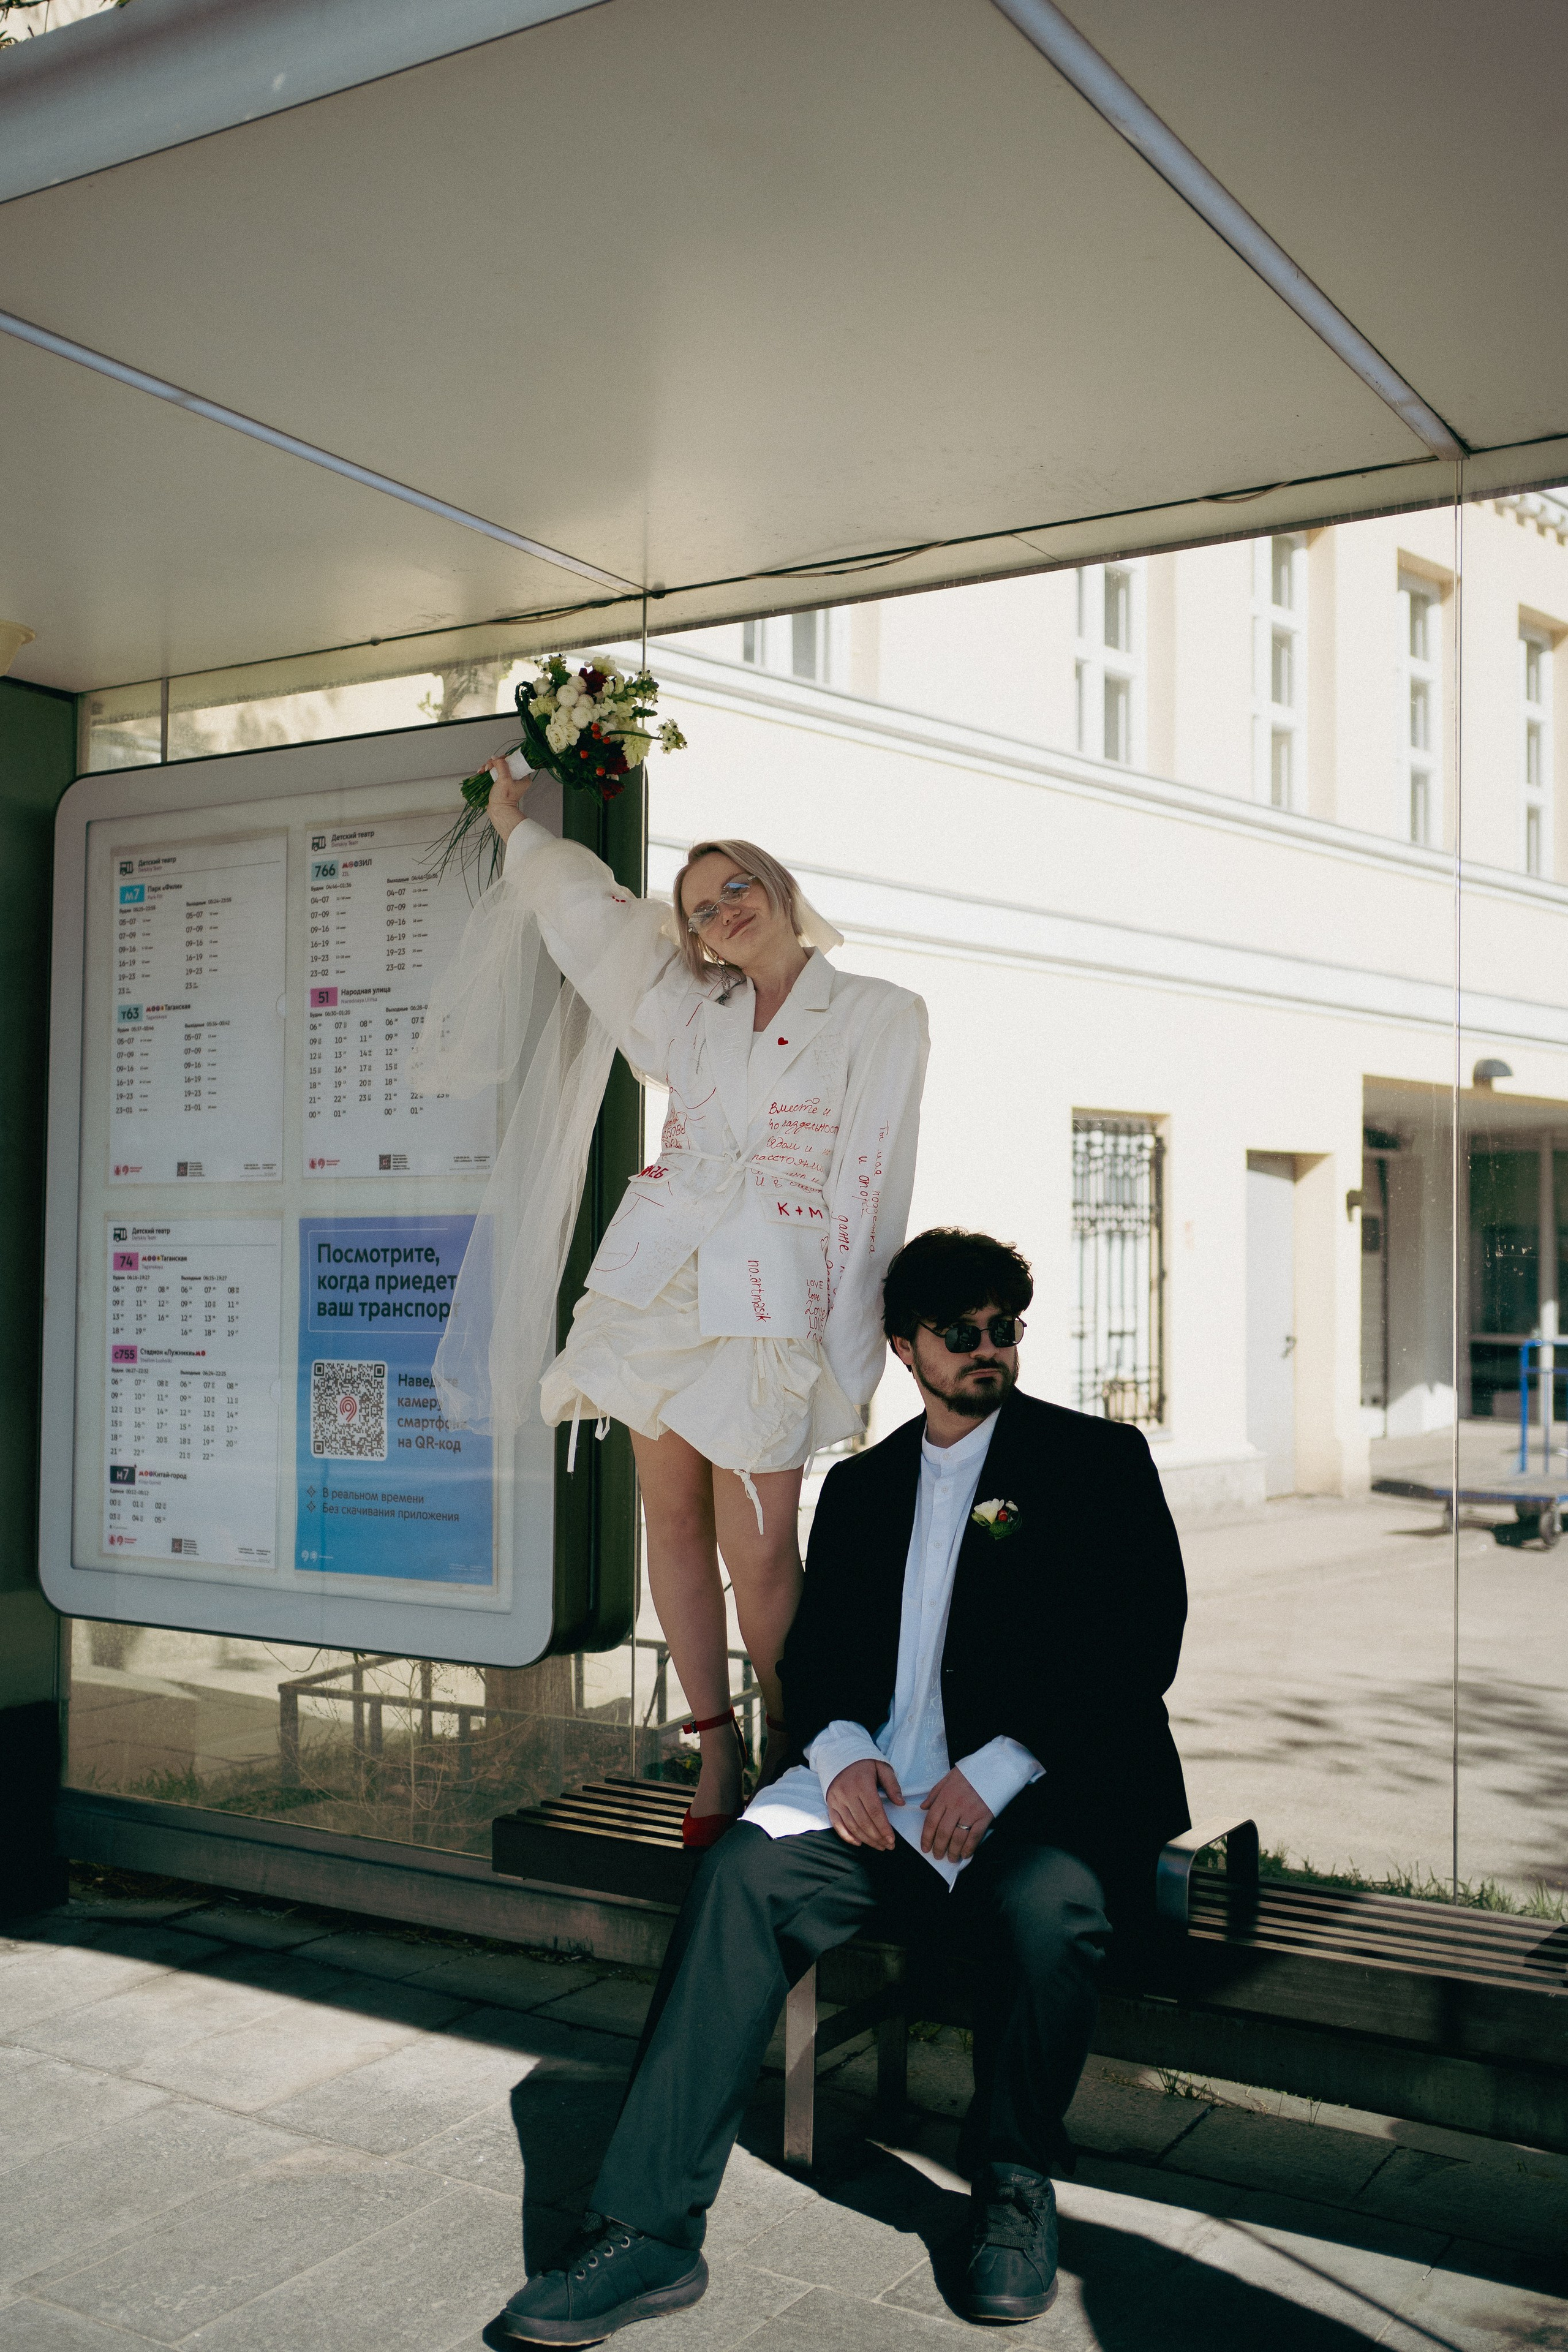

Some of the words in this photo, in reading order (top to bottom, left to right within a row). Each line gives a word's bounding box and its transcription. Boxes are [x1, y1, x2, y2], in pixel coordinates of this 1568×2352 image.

[331, 834, 356, 842] Детский
[138, 859, 160, 867] Детский
[315, 864, 336, 878] 766
[318, 991, 330, 1004] 51
[341, 988, 371, 997] Народная
[372, 987, 391, 995] улица
[121, 1008, 140, 1020] т63
[317, 1243, 440, 1266] Посмотрите,
[120, 1256, 133, 1268] 74
[317, 1274, 370, 1292] когда
[375, 1273, 457, 1294] приедет
[806, 1278, 824, 1289] LOVE
[317, 1302, 353, 1317] ваш
[114, 1349, 135, 1359] с755
[398, 1438, 412, 1448] на
[415, 1435, 461, 1454] QR-код
[153, 1470, 187, 1480] Китай-город
[323, 1488, 328, 1498] В
[331, 1489, 379, 1502] реальном
[381, 1493, 424, 1504] времени
[322, 1503, 339, 1513] Без
[342, 1506, 395, 1517] скачивания
[398, 1510, 459, 1521] приложения
